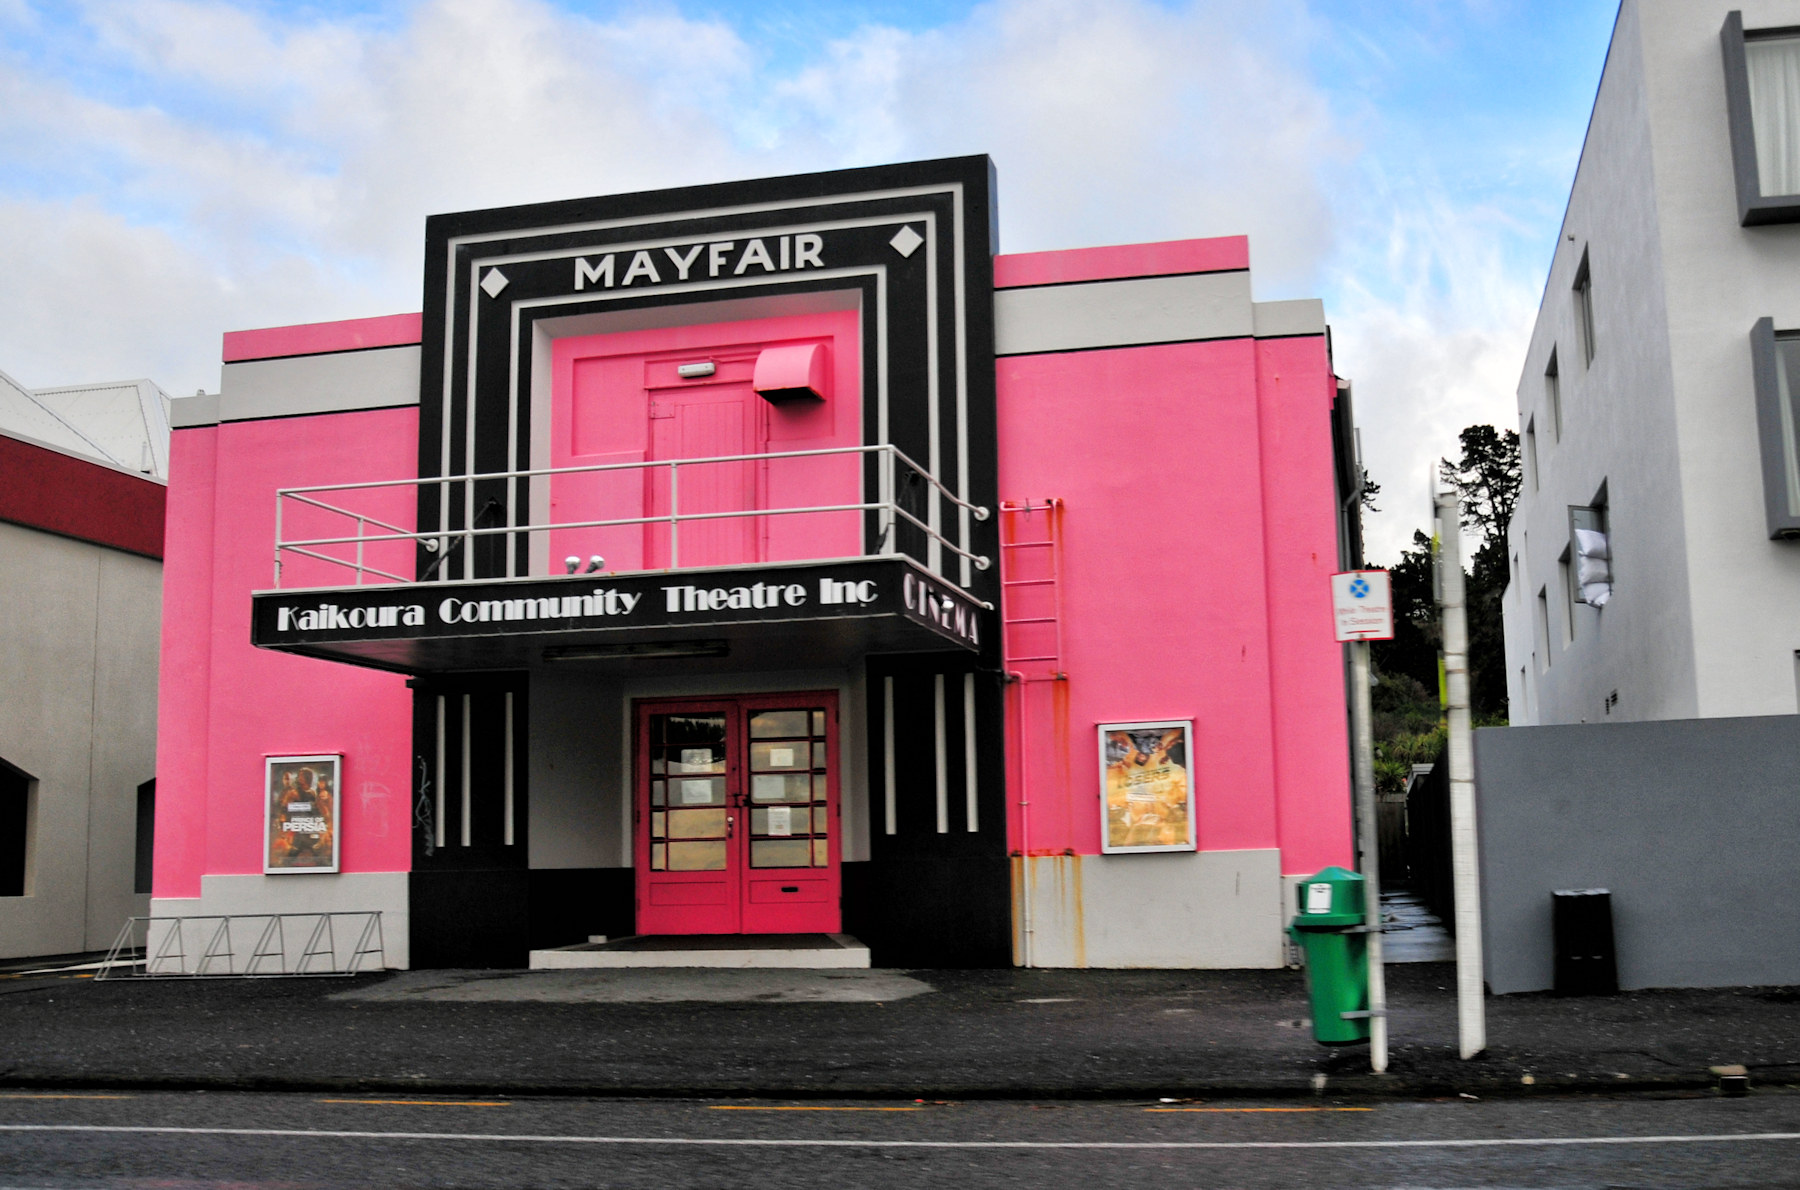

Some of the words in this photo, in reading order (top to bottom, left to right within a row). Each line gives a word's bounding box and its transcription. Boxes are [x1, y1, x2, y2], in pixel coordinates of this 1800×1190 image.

[574, 234, 824, 290] MAYFAIR
[277, 604, 425, 631] Kaikoura
[439, 588, 643, 624] Community
[661, 582, 807, 612] Theatre
[819, 577, 878, 606] Inc
[903, 573, 979, 645] CINEMA
[283, 822, 327, 832] PERSIA
